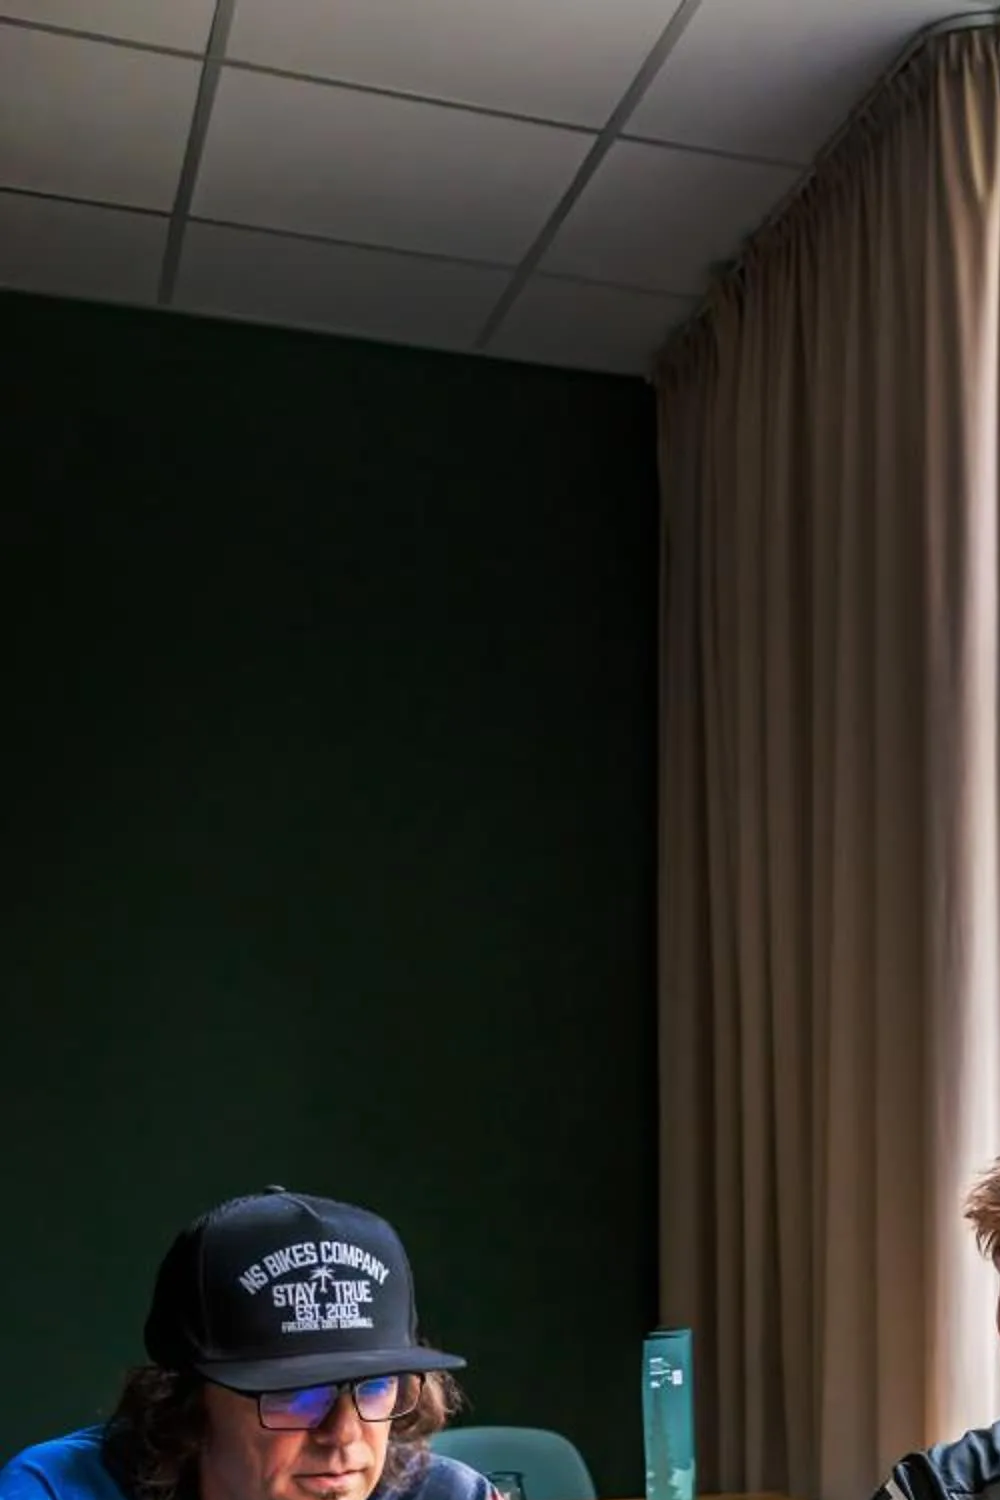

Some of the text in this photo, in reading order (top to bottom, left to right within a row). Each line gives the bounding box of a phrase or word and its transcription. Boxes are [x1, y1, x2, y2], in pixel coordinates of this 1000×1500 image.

[238, 1241, 390, 1295] NS BIKES COMPANY
[272, 1280, 373, 1307] STAY TRUE
[295, 1302, 359, 1321] EST. 2003
